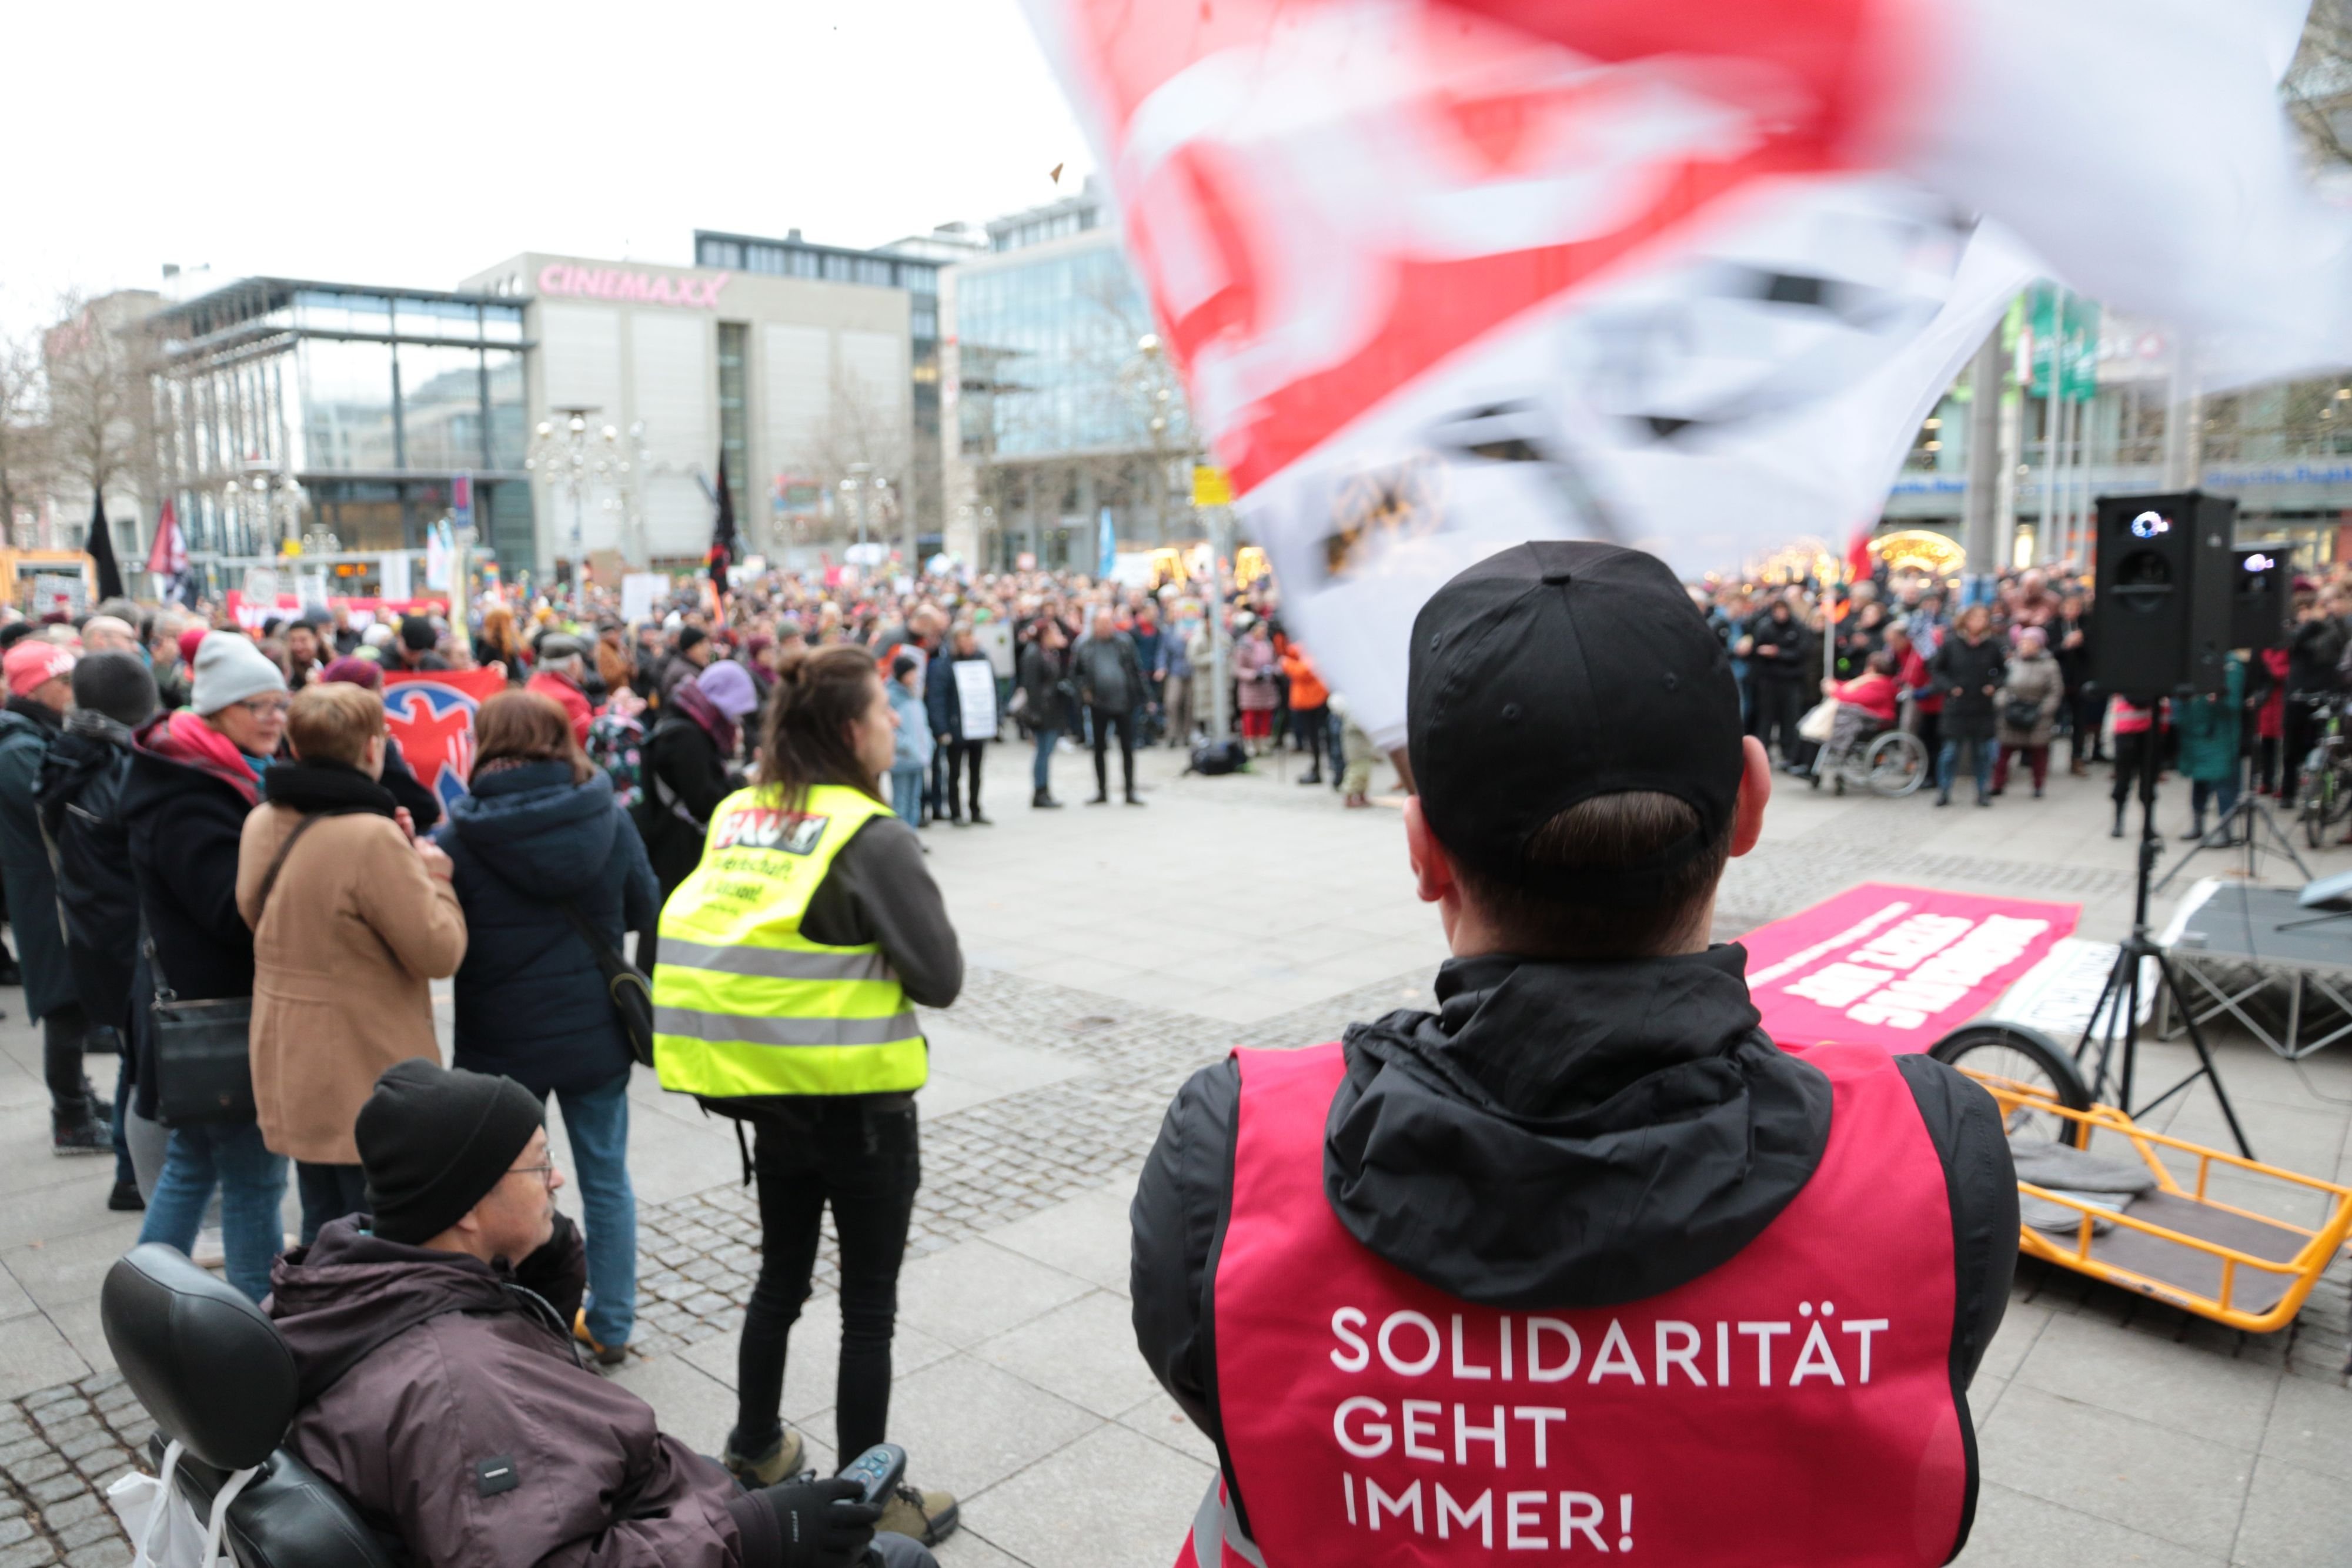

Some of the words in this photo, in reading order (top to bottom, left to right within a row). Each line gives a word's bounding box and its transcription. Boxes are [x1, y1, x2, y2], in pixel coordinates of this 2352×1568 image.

[538, 263, 730, 308] CINEMAXX
[715, 812, 789, 847] FAU
[1330, 1300, 1889, 1386] SOLIDARITÄT
[1333, 1396, 1566, 1468] GEHT
[1343, 1473, 1633, 1552] IMMER!
